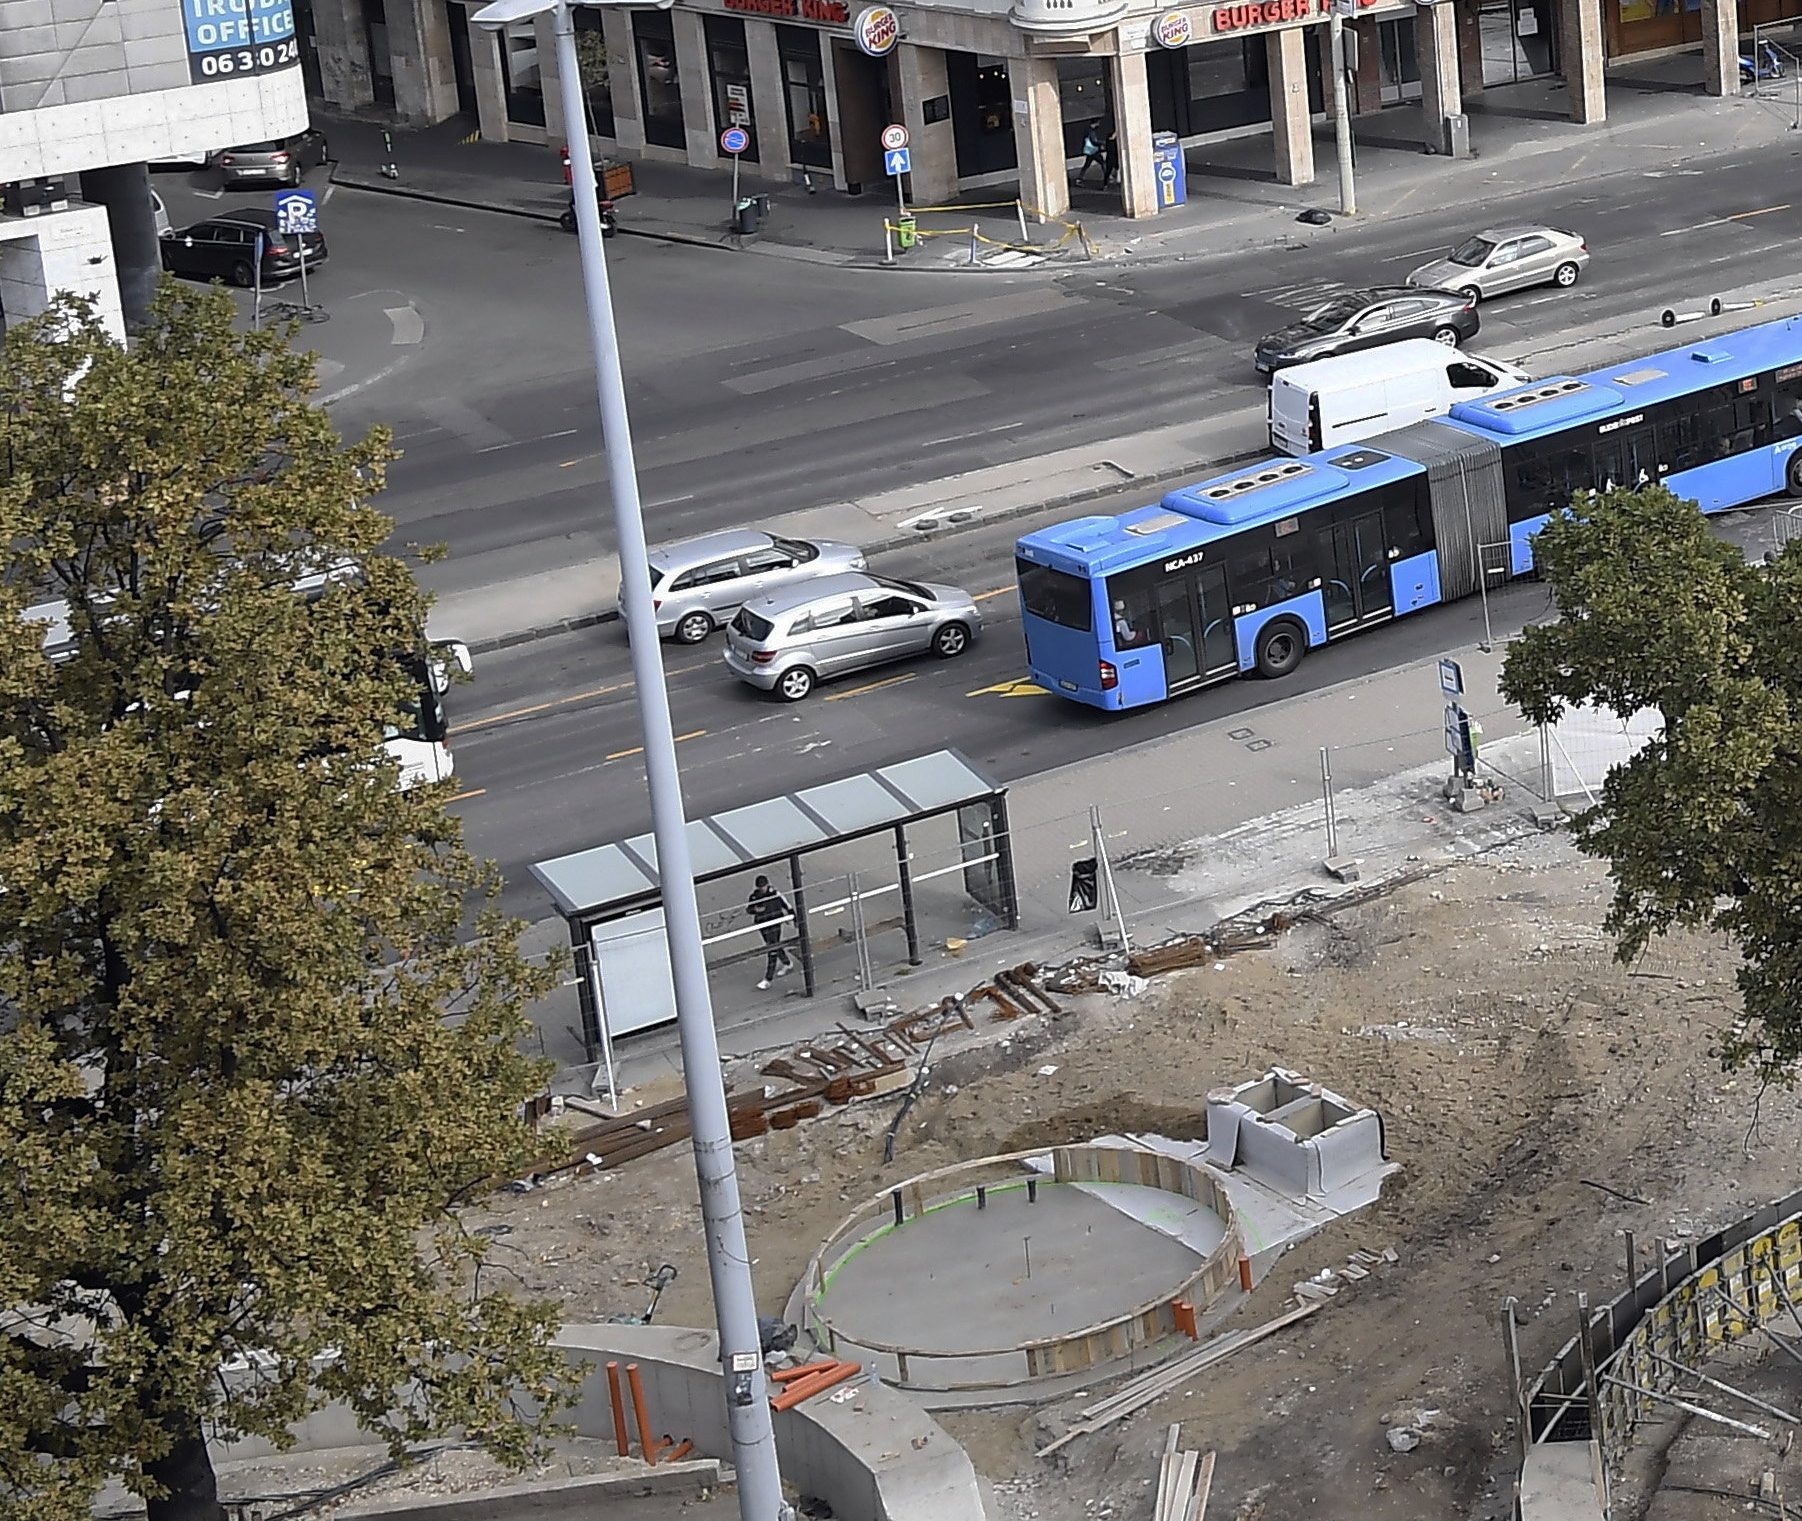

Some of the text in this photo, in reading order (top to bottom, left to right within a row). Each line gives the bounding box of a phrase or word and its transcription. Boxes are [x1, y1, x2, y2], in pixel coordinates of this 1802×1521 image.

[197, 9, 294, 45] OFFICE
[865, 12, 894, 36] BURGER
[867, 21, 897, 49] KING
[1161, 23, 1189, 43] KING
[201, 53, 234, 76] 06
[889, 131, 901, 143] 30
